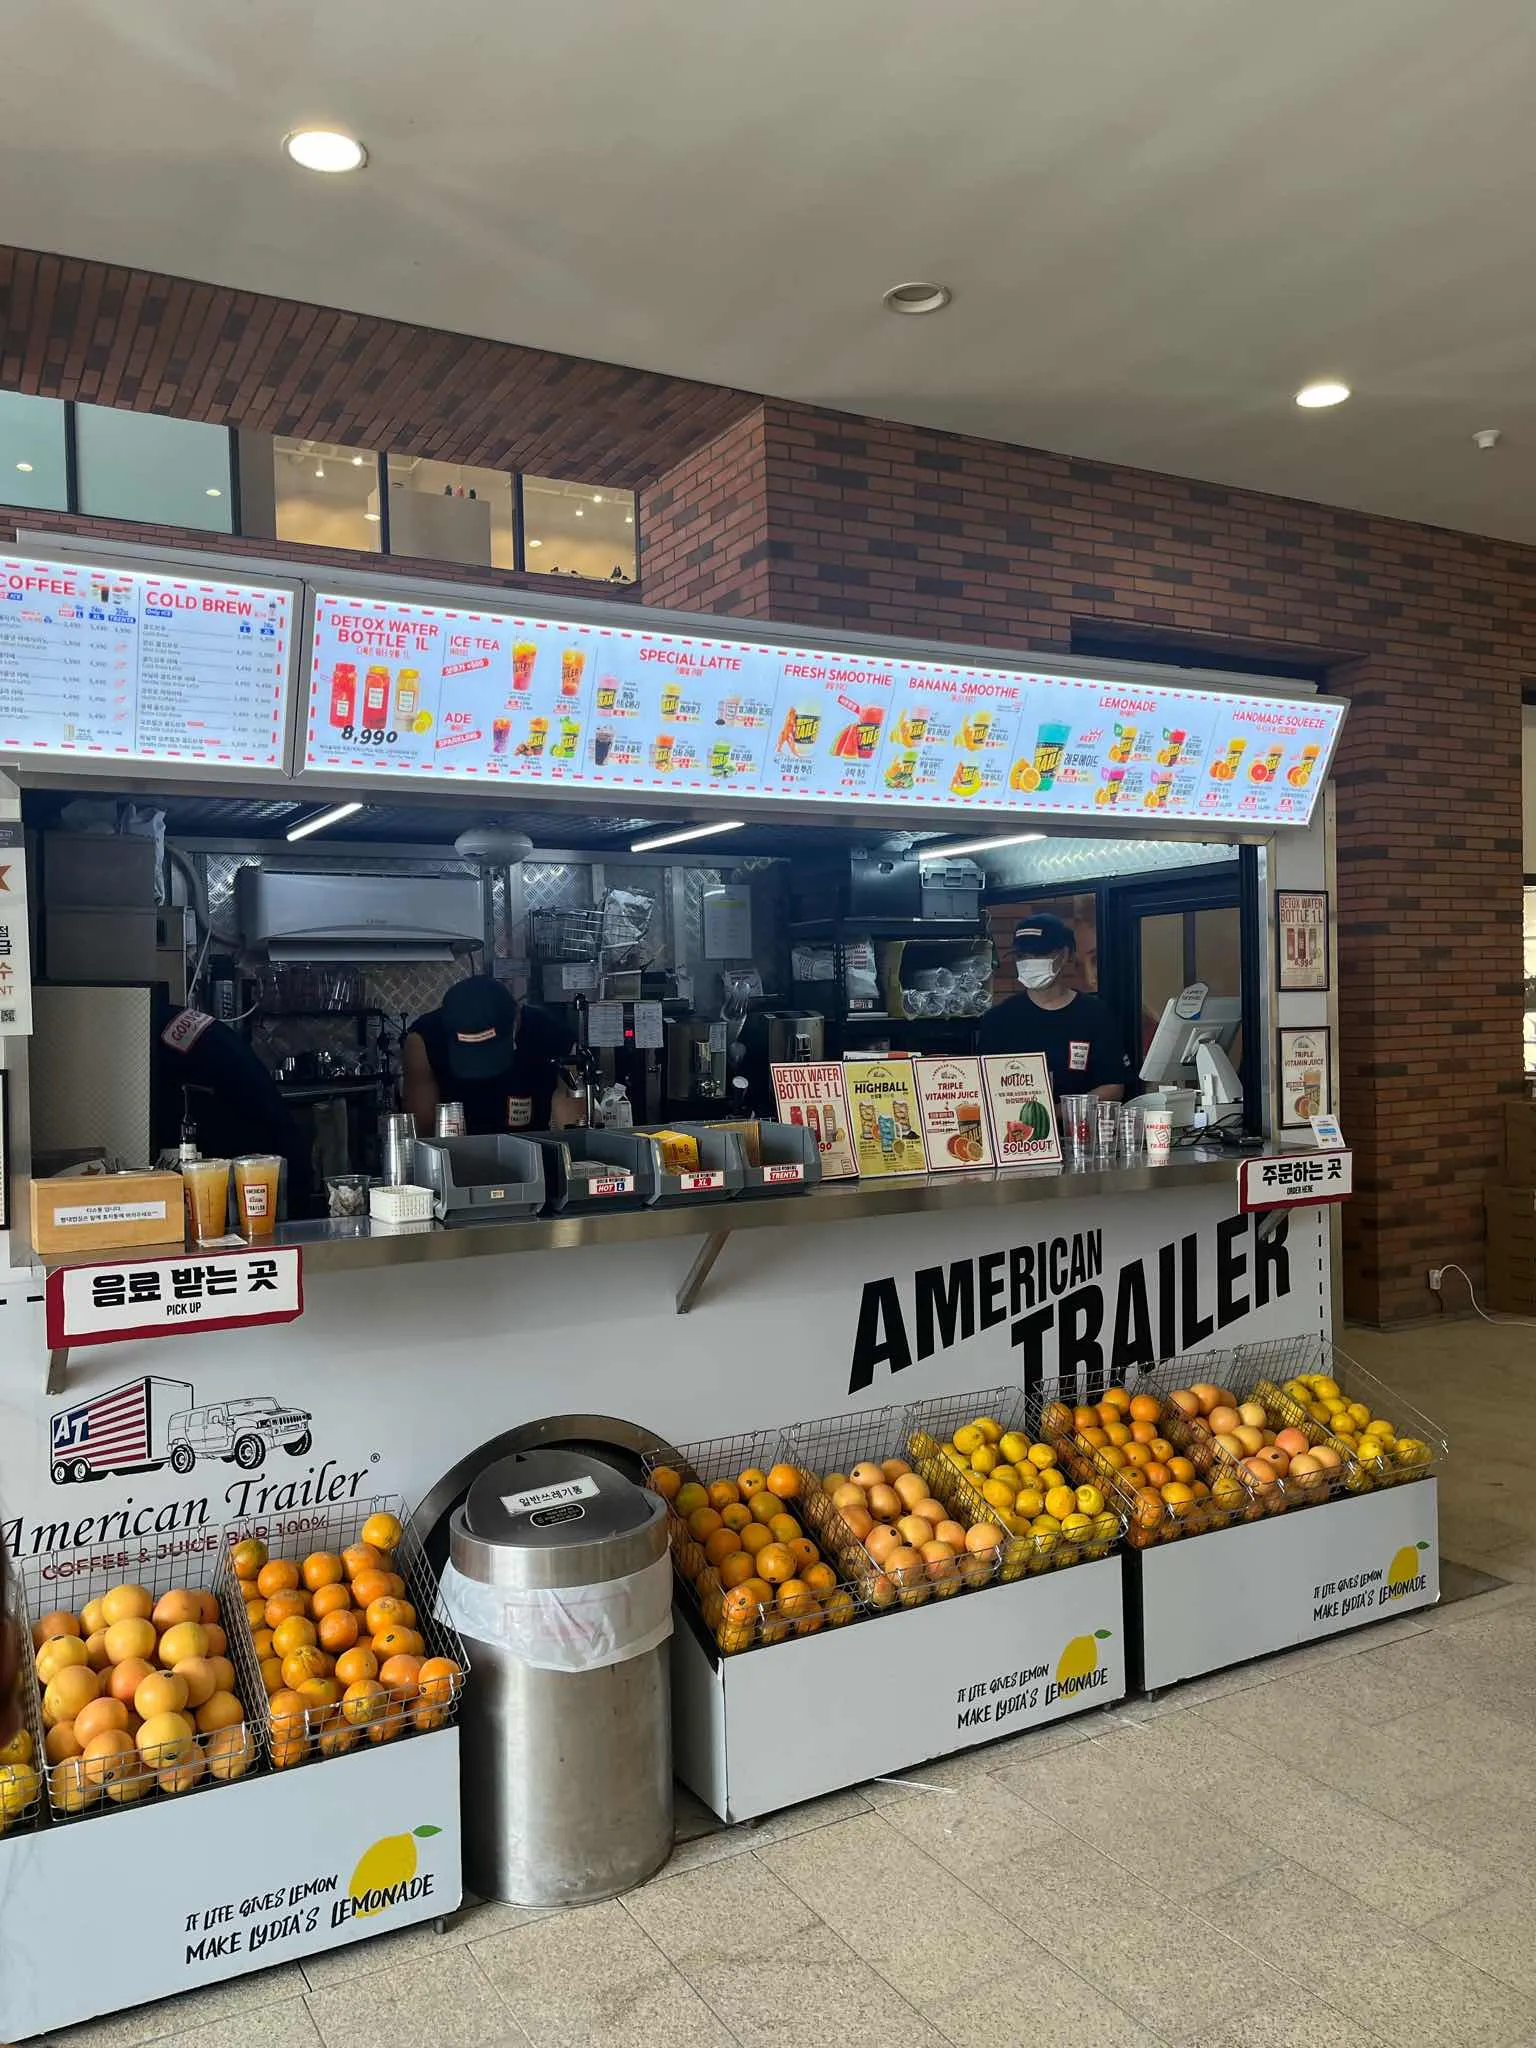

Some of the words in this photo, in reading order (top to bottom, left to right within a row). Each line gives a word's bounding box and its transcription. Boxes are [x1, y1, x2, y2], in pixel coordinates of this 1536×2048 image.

[147, 591, 197, 609] COLD
[203, 598, 251, 616] BREW
[332, 614, 384, 631] DETOX
[389, 620, 439, 636] WATER
[339, 629, 406, 648] BOTTLE
[416, 637, 429, 650] 1L
[450, 635, 471, 648] ICE
[475, 638, 500, 651] TEA
[640, 648, 696, 665] SPECIAL
[700, 656, 741, 670] LATTE
[784, 664, 826, 679] FRESH
[828, 669, 893, 686] SMOOTHIE
[909, 677, 957, 692] BANANA
[960, 683, 1019, 698] SMOOTHIE
[1099, 697, 1157, 712] LEMONADE
[444, 712, 472, 724] ADE
[1232, 711, 1283, 725] HANDMADE
[1286, 716, 1326, 729] SQUEEZE
[341, 724, 398, 745] 8,990
[1063, 752, 1100, 768] 레몬에이드
[1280, 896, 1299, 909] DETOX
[1302, 897, 1323, 909] WATER
[1280, 909, 1309, 923] BOTTLE
[1284, 1058, 1307, 1067] VITAMIN
[776, 1069, 806, 1083] DETOX
[808, 1067, 840, 1082] WATER
[1001, 1073, 1034, 1087] NOTICE!
[778, 1083, 821, 1100] BOTTLE
[855, 1082, 908, 1094] HIGHBALL
[925, 1091, 956, 1101] VITAMIN
[957, 1091, 979, 1099] JUICE
[937, 1082, 964, 1090] TRIPLE
[1003, 1140, 1053, 1154] SOLDOUT
[771, 1170, 797, 1179] TRENTA
[1262, 1160, 1324, 1186] 주문하는
[1327, 1158, 1342, 1179] 곳
[597, 1184, 614, 1192] HOT
[1286, 1185, 1302, 1195] ORDER
[1302, 1184, 1314, 1194] HERE
[92, 1271, 162, 1308] 음료
[170, 1265, 238, 1300] 받는
[247, 1259, 278, 1293] 곳
[166, 1303, 188, 1316] PICK
[189, 1302, 202, 1315] UP
[848, 1228, 1102, 1395] AMERICAN
[1011, 1211, 1292, 1407] TRAILER
[54, 1412, 89, 1446] AT
[519, 1485, 583, 1507] 일반쓰레기통
[0, 1497, 210, 1558] American
[225, 1459, 368, 1519] Trailer
[42, 1551, 129, 1581] COFFEE
[136, 1546, 151, 1563] &
[157, 1534, 218, 1561] JUICE
[227, 1526, 268, 1547] BAR
[276, 1514, 329, 1537] 100%
[1313, 1585, 1321, 1599] IF
[1321, 1582, 1336, 1599] LIFE
[1337, 1574, 1359, 1593] GIVES
[1360, 1569, 1383, 1588] LEMON
[1313, 1601, 1339, 1621] MAKE
[1341, 1589, 1375, 1617] LYDIA'S
[1378, 1574, 1427, 1606] LEMONADE
[957, 1688, 967, 1703] IF
[968, 1682, 988, 1702] LIFE
[989, 1671, 1019, 1693] GIVES
[1019, 1663, 1050, 1687] LEMON
[957, 1705, 992, 1729] MAKE
[995, 1687, 1039, 1722] LYDIA'S
[1045, 1668, 1108, 1706] LEMONADE
[185, 1912, 200, 1932] IF
[203, 1904, 235, 1931] LIFE
[238, 1888, 286, 1917] GIVES
[288, 1874, 339, 1906] LEMON
[185, 1932, 242, 1964] MAKE
[248, 1906, 321, 1952] LYDIA'S
[330, 1874, 435, 1929] LEMONADE
